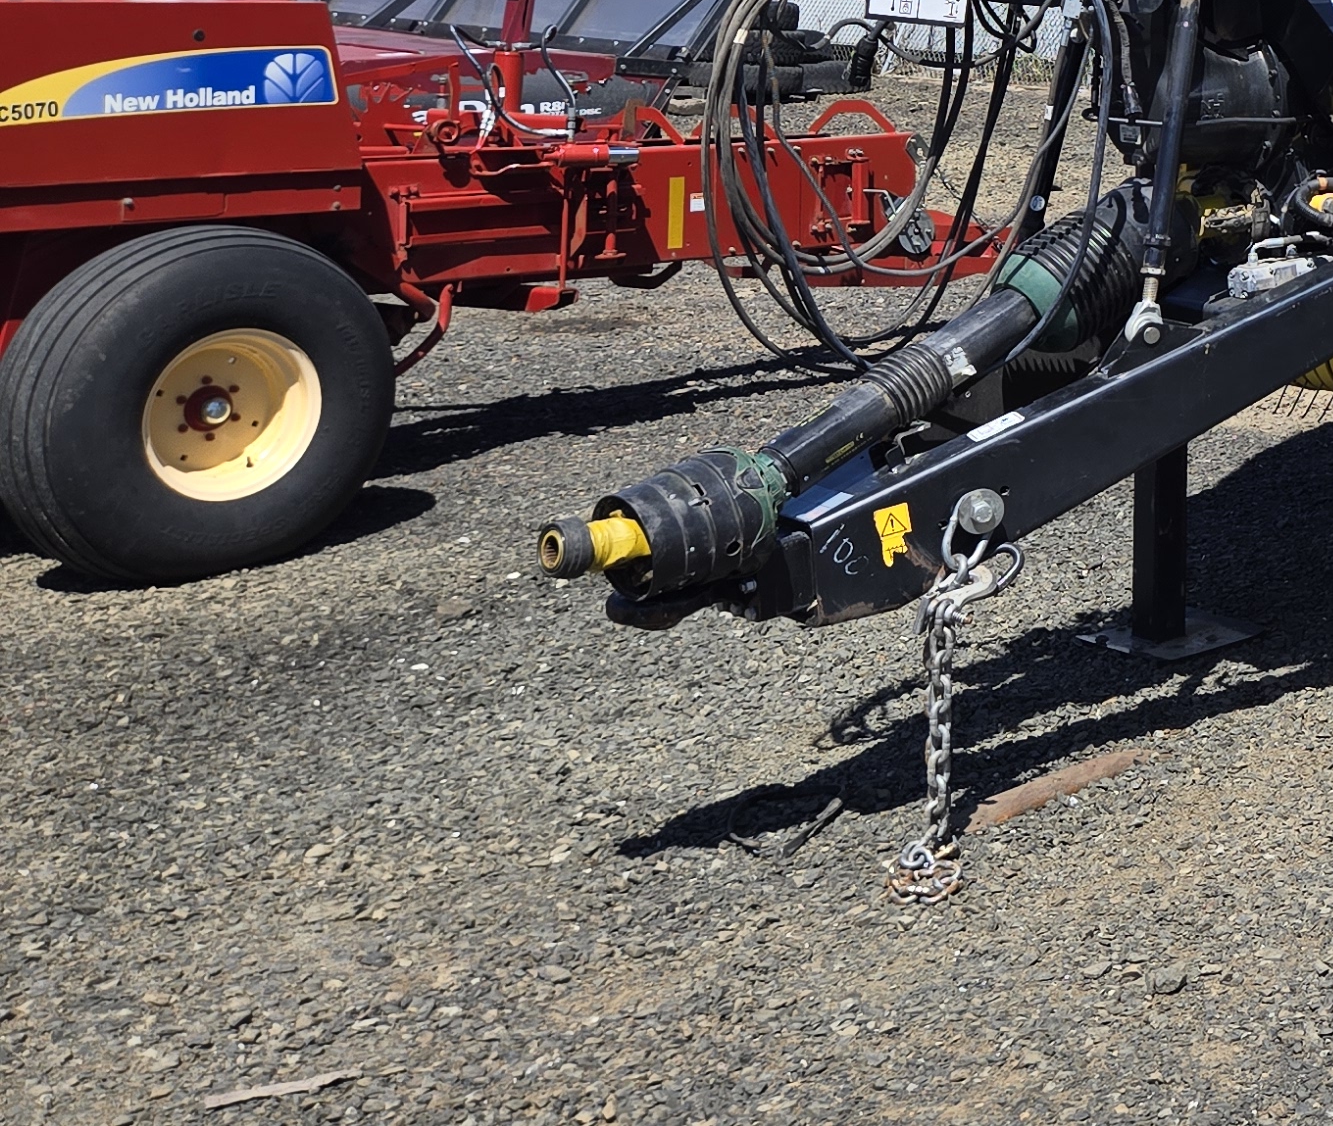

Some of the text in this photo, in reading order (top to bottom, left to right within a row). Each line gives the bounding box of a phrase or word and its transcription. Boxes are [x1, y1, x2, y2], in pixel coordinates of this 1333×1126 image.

[104, 85, 256, 114] New Holland
[579, 107, 602, 116] DISC
